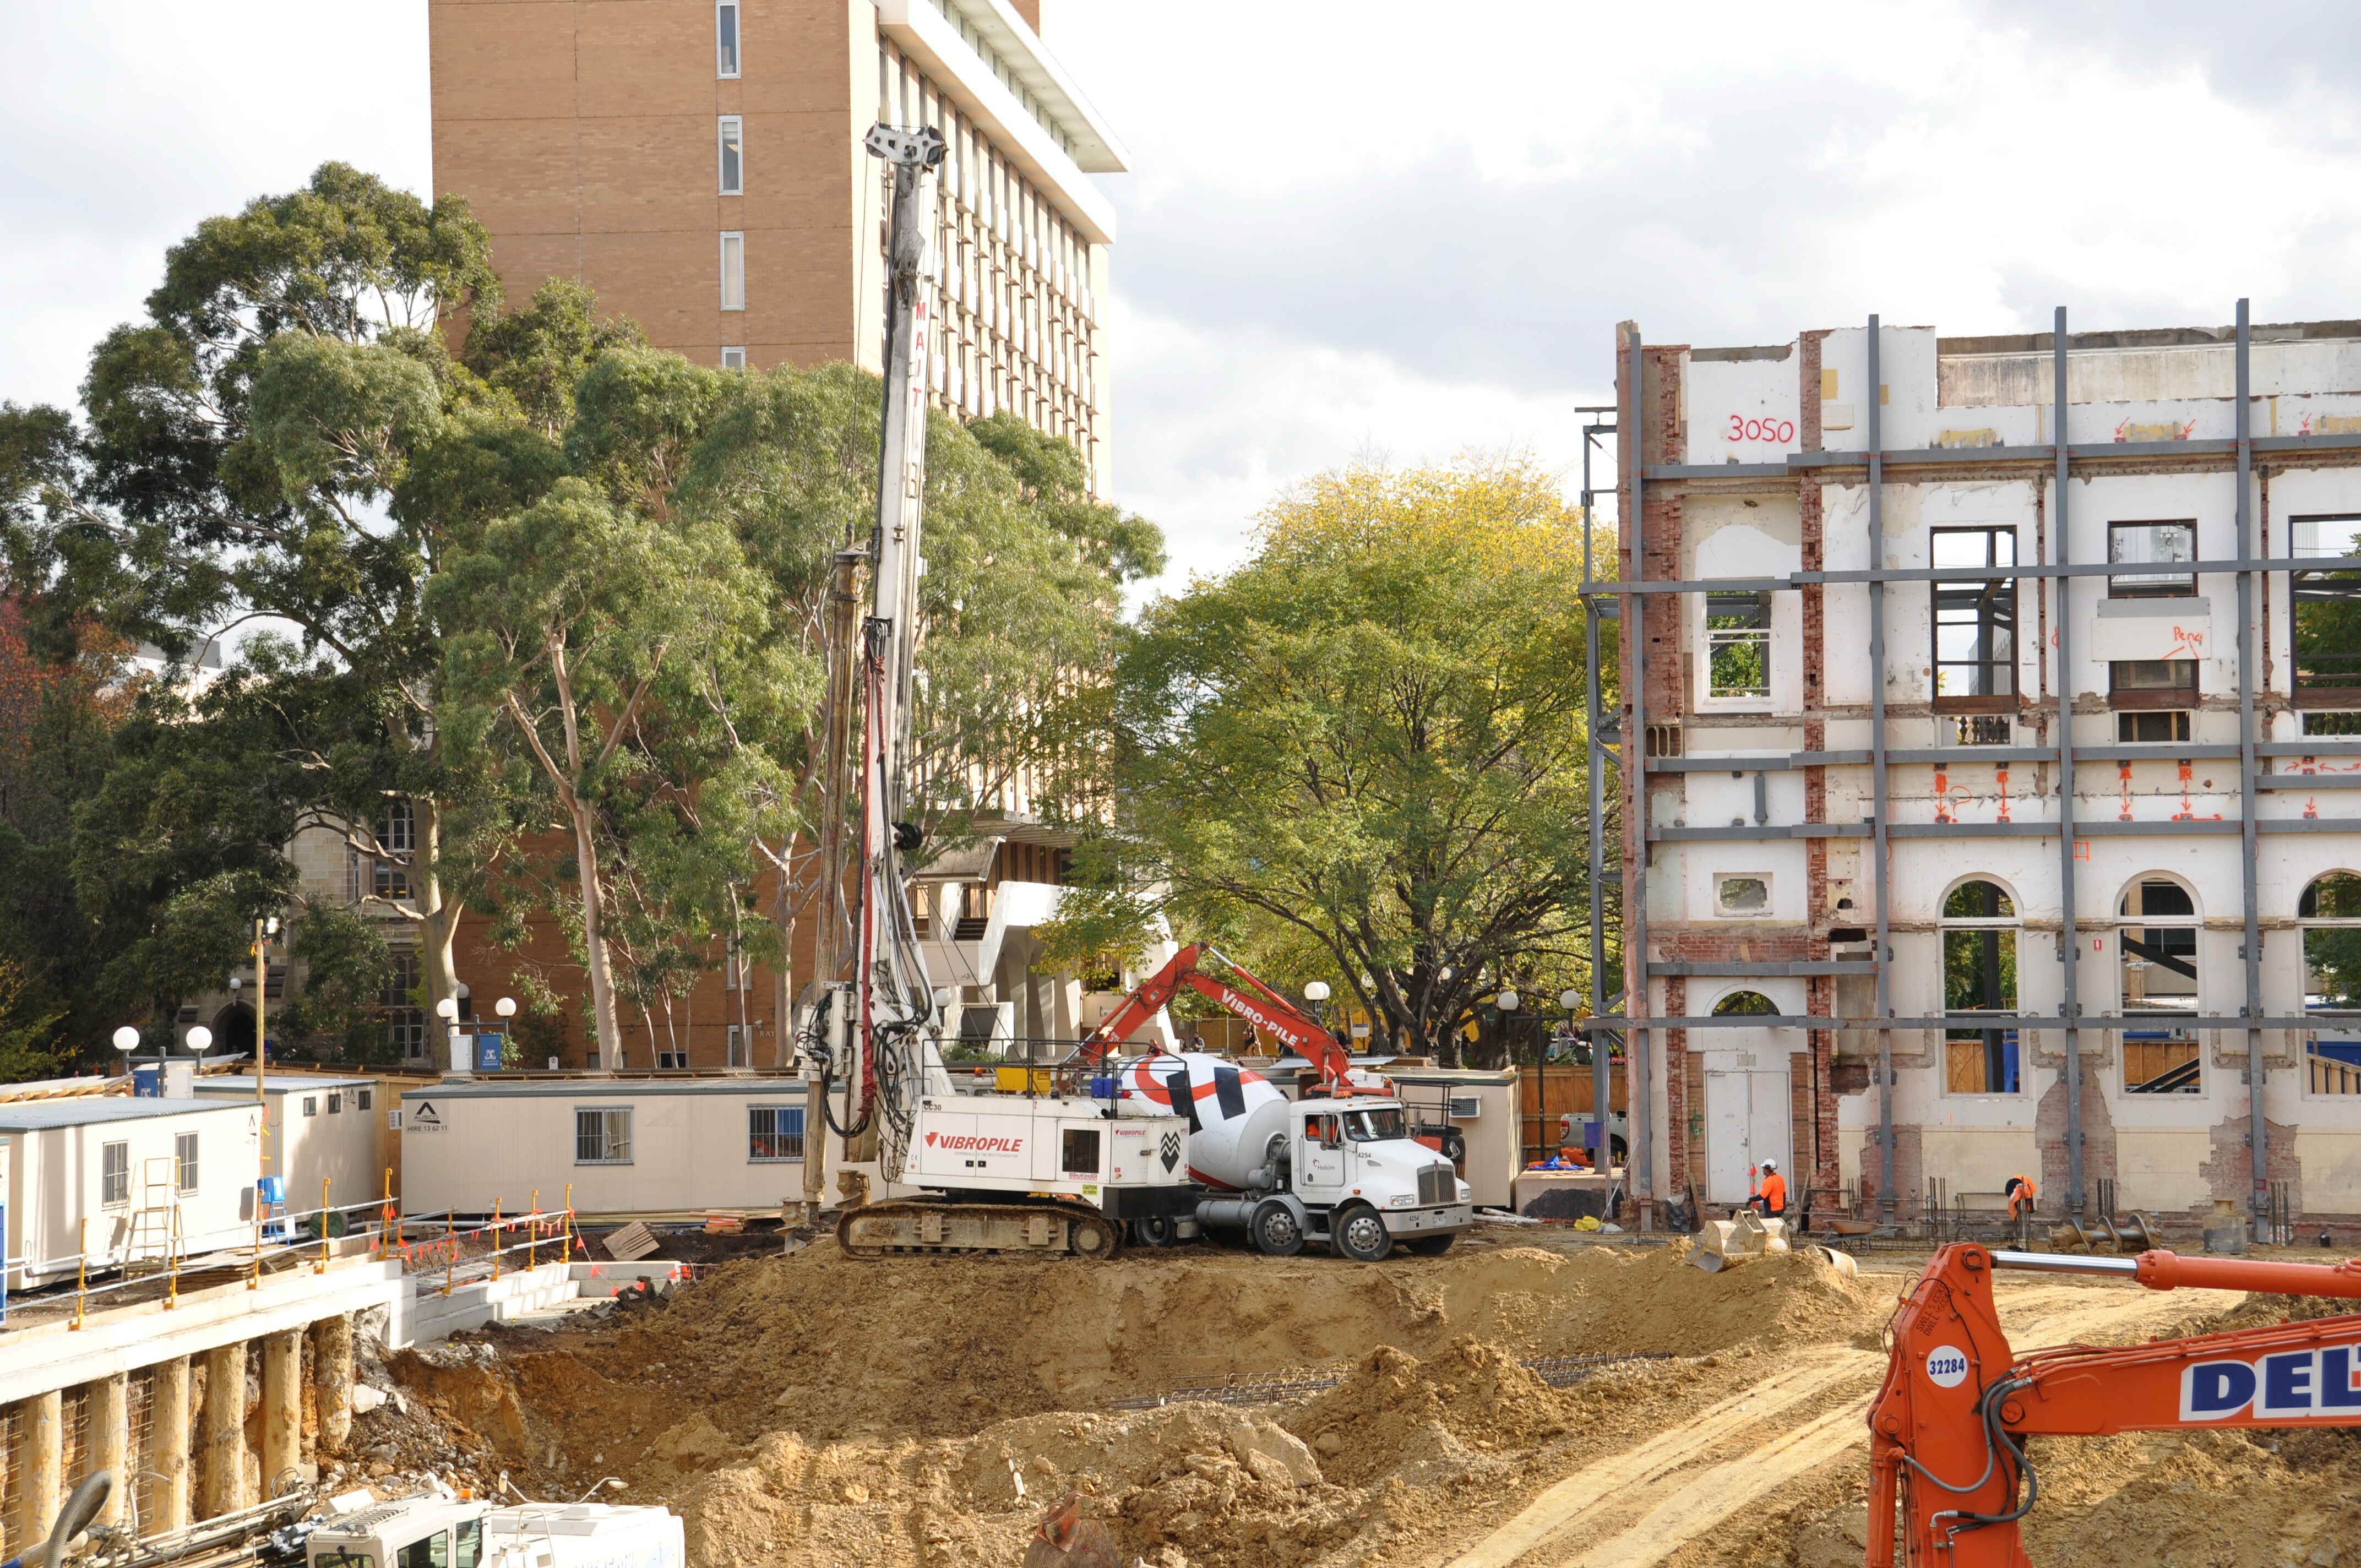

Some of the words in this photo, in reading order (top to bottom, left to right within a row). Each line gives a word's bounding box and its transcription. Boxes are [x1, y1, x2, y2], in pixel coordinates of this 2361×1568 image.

[912, 302, 926, 407] MAIT
[1221, 988, 1299, 1046] VIBRO-PILE
[940, 1135, 1023, 1152] VIBROPILE
[1929, 1358, 1965, 1375] 32284
[2179, 1344, 2361, 1421] DEL
